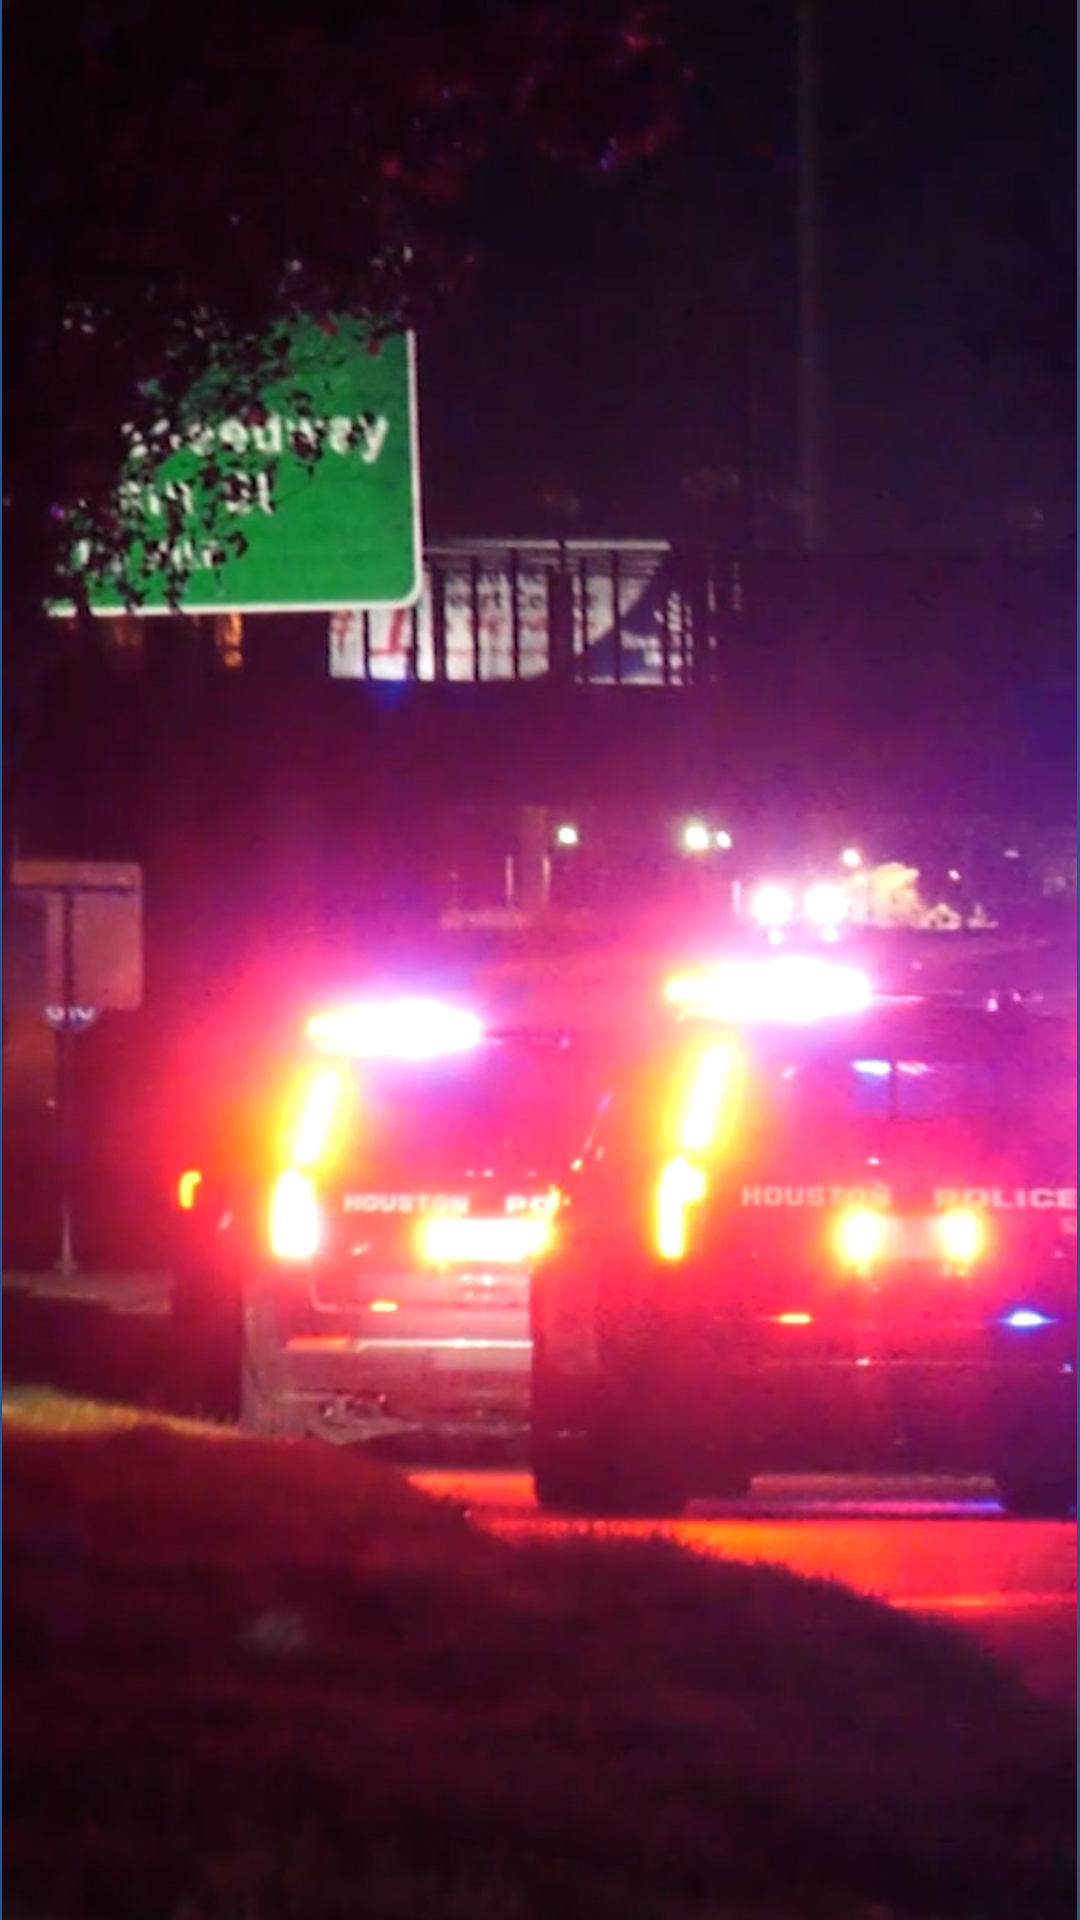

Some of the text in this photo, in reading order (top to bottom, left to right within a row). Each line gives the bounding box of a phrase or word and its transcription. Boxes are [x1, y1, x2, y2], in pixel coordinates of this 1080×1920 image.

[343, 1194, 469, 1213] HOUSTON
[741, 1187, 1077, 1208] HOUSTON POLICE
